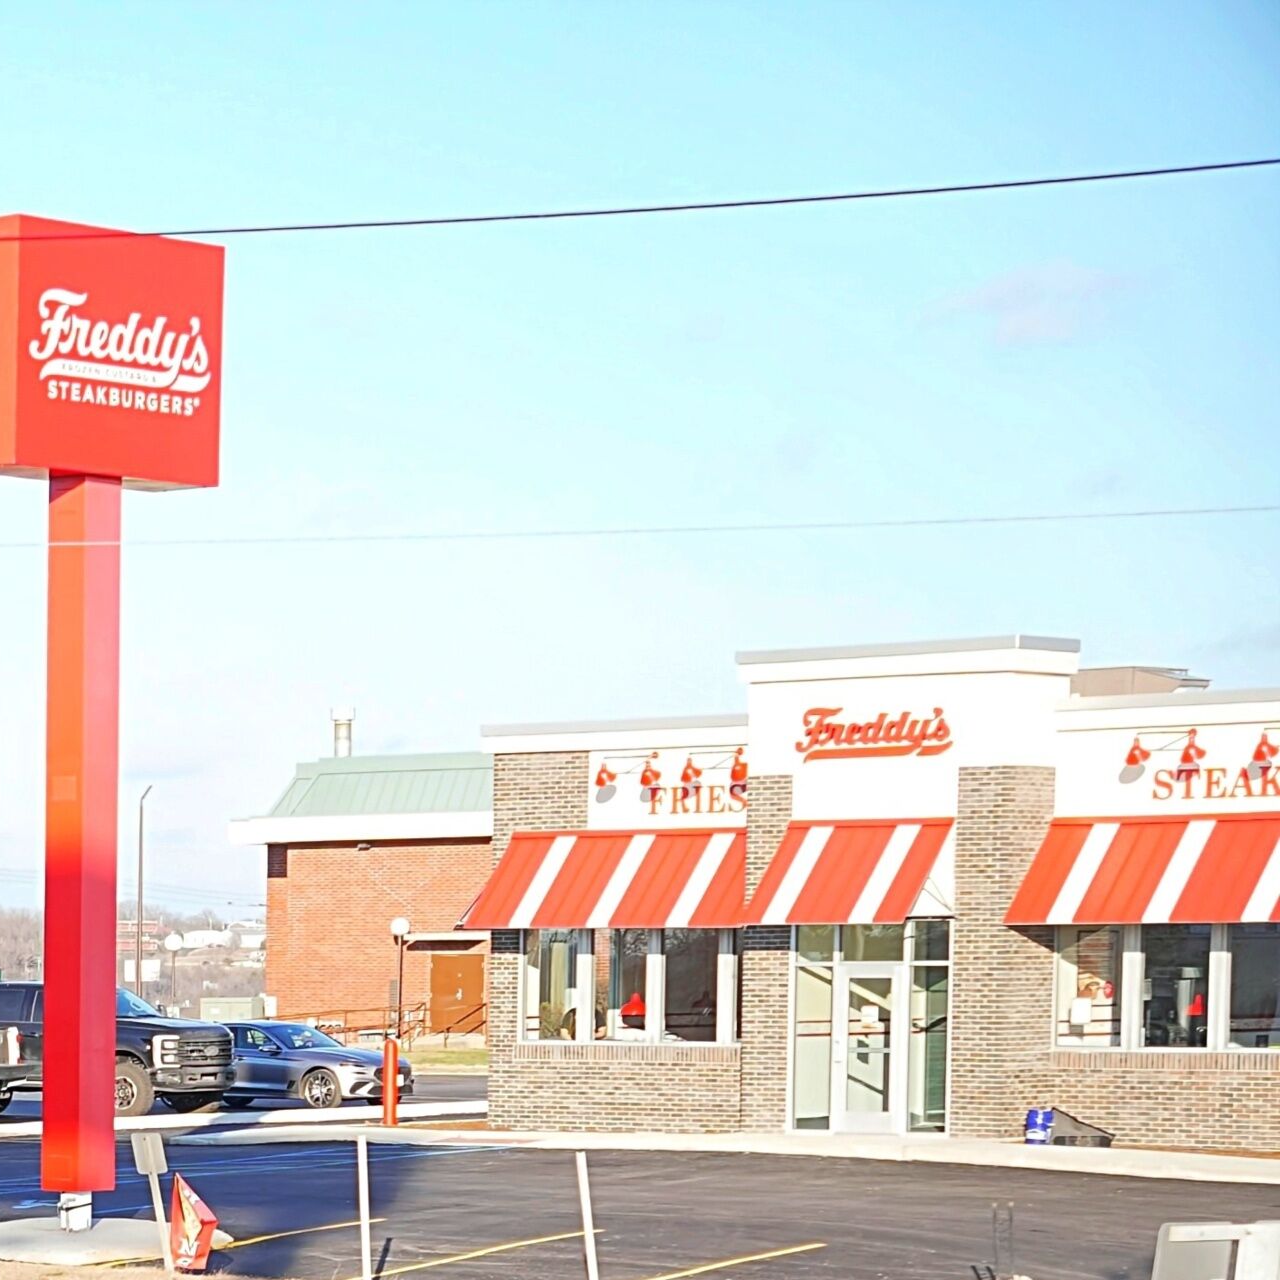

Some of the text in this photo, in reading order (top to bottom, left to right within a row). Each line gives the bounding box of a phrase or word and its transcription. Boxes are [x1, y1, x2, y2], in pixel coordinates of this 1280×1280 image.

[29, 287, 211, 388] Freddy's
[795, 707, 953, 763] Freddy's
[647, 784, 748, 815] FRIES
